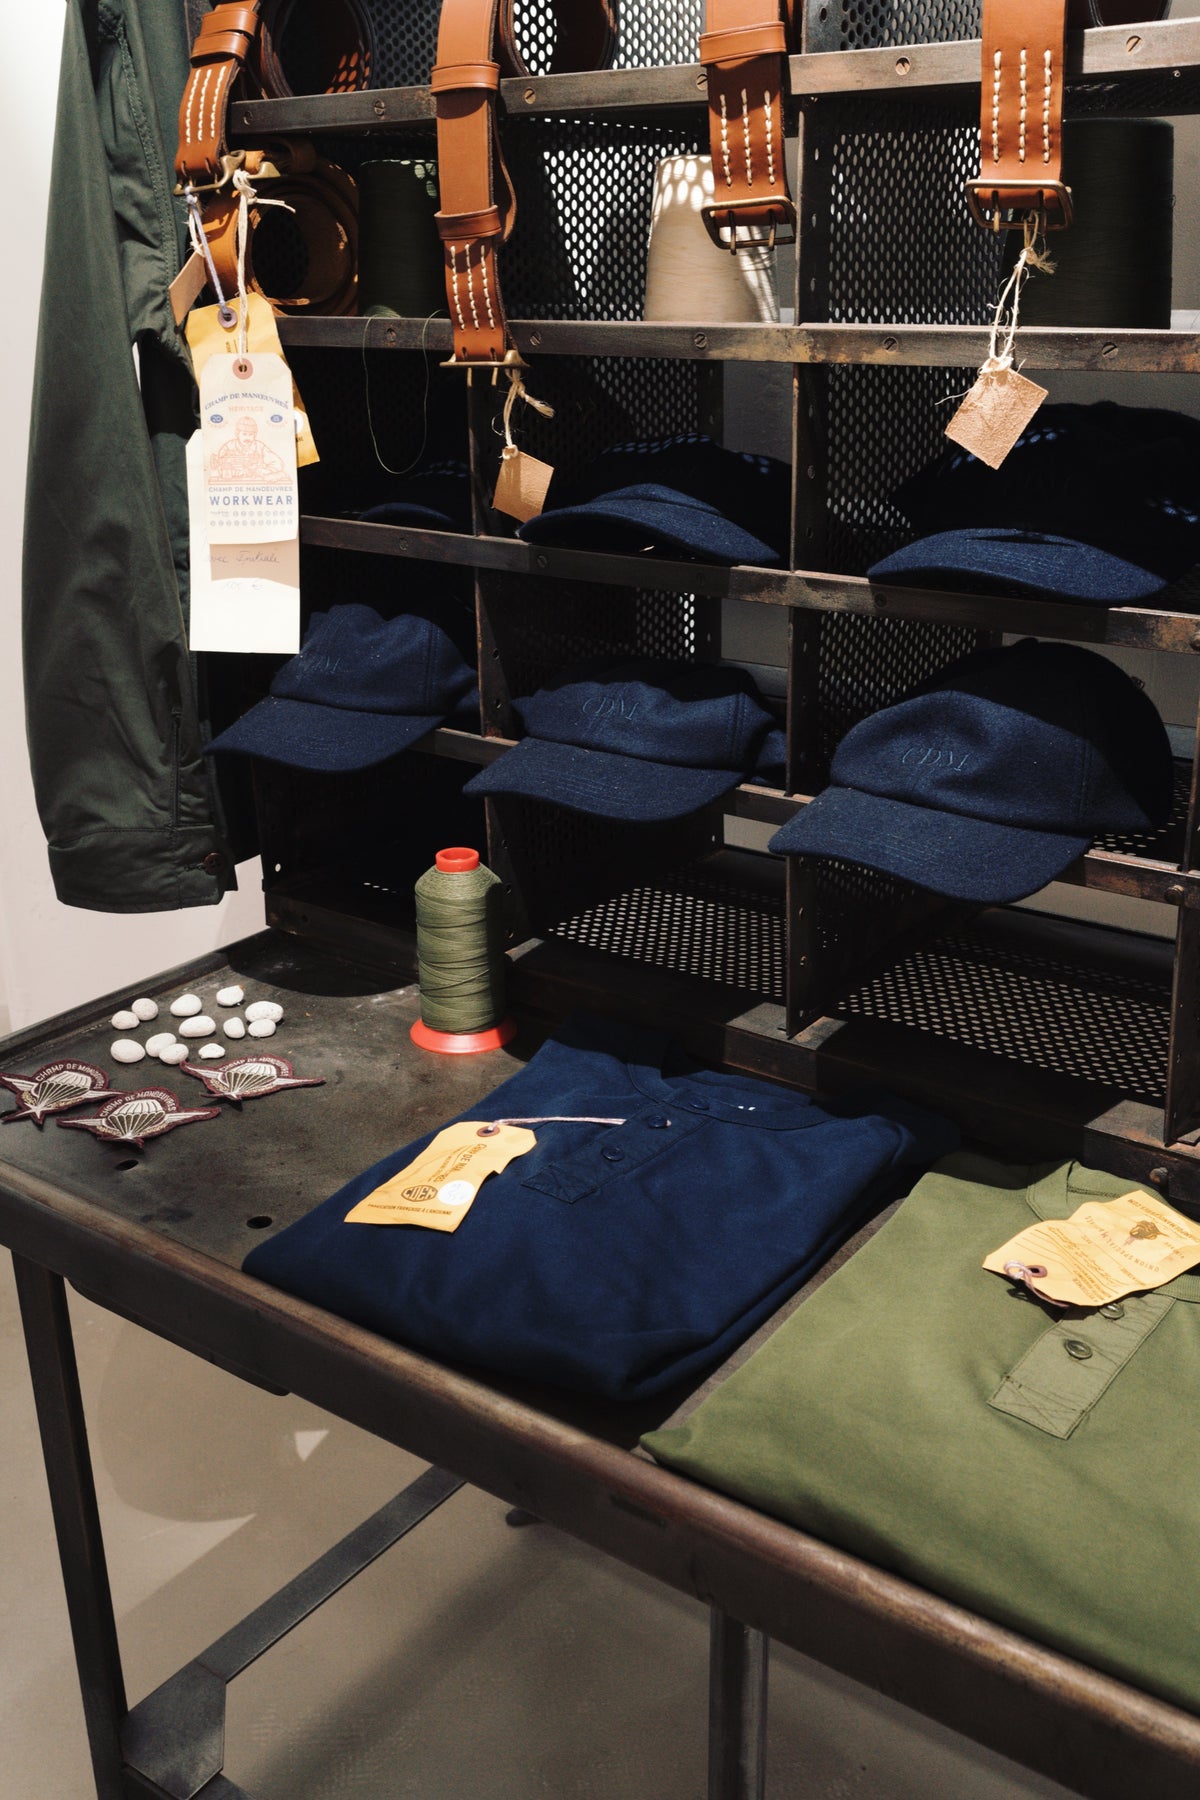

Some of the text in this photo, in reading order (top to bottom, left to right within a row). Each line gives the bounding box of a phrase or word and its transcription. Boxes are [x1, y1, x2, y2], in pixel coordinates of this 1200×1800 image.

[204, 395, 229, 411] CHAMP
[230, 392, 241, 400] DE
[209, 495, 293, 506] WORKWEAR
[35, 1064, 64, 1082] CHAMP
[99, 1098, 123, 1118] CHAMP
[124, 1093, 136, 1102] DE
